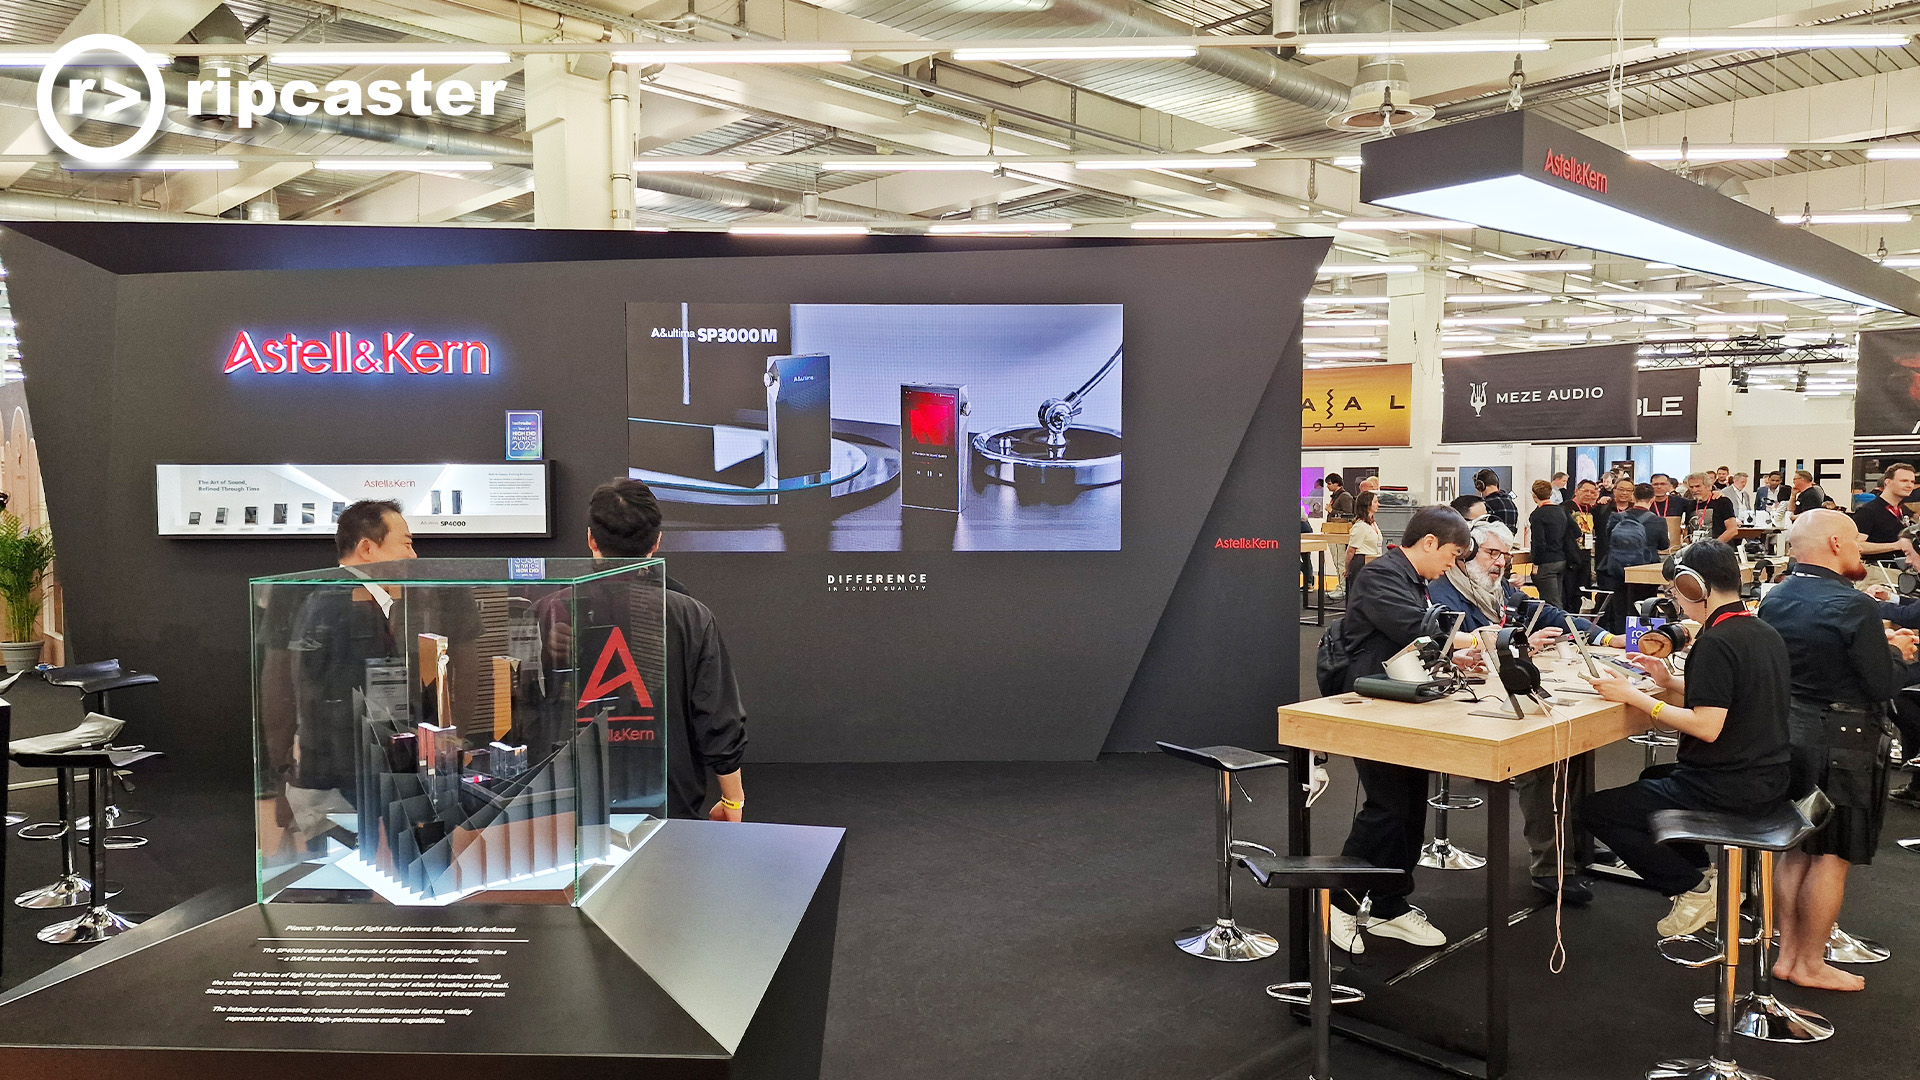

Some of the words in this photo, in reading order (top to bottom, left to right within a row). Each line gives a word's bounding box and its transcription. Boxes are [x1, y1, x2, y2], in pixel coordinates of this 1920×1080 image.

[1544, 148, 1608, 194] Astell&Kern
[651, 328, 695, 338] A&ultima
[223, 330, 491, 375] Astell&Kern
[1496, 391, 1541, 404] MEZE
[1547, 386, 1603, 401] AUDIO
[1637, 396, 1684, 416] LE
[512, 440, 537, 451] 2025
[364, 479, 416, 488] Astell&Kern
[1214, 537, 1279, 549] Astell&Kern
[827, 574, 928, 584] DIFFERENCE
[315, 924, 331, 932] The
[363, 925, 384, 933] light
[399, 925, 431, 933] pierces
[432, 925, 464, 933] through
